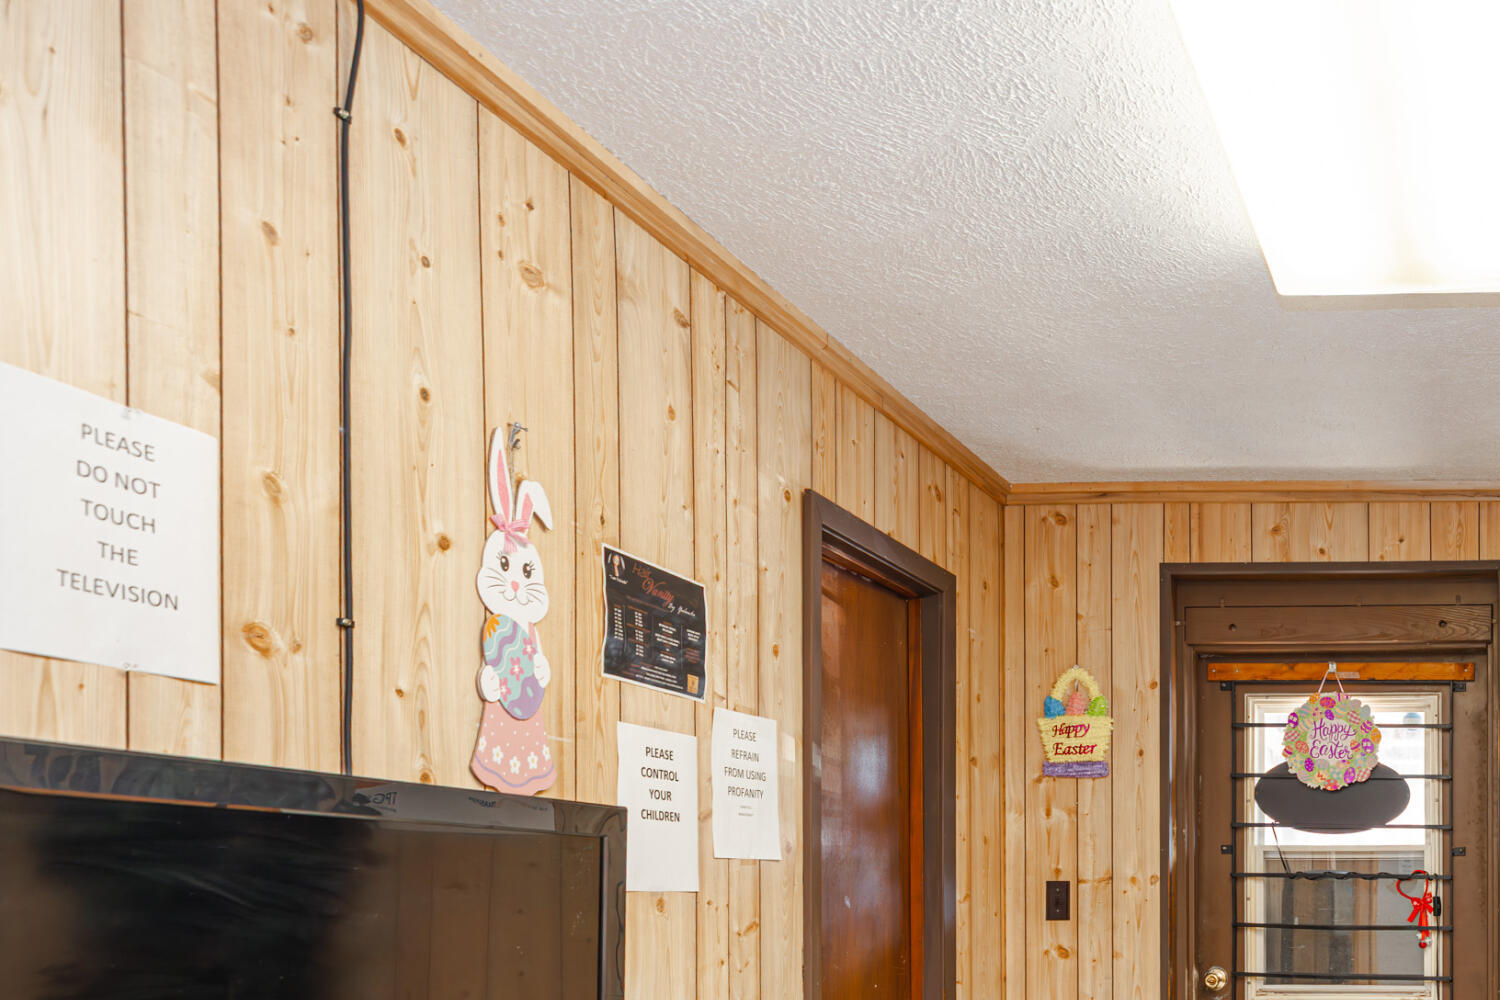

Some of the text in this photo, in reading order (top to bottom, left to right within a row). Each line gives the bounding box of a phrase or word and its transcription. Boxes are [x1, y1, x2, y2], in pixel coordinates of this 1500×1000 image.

[81, 423, 156, 462] PLEASE
[76, 460, 161, 499] DO NOT
[81, 499, 156, 534] TOUCH
[97, 541, 139, 566] THE
[57, 568, 179, 611] TELEVISION
[733, 728, 757, 742] PLEASE
[1051, 720, 1091, 738] Happy
[1311, 719, 1357, 741] Happy
[645, 746, 674, 760] PLEASE
[731, 748, 760, 762] REFRAIN
[1053, 741, 1097, 757] Easter
[1309, 740, 1354, 759] Easter
[641, 767, 679, 782] CONTROL
[724, 766, 767, 782] FROM USING
[649, 789, 672, 801] YOUR
[727, 785, 764, 799] PROFANITY
[641, 809, 680, 822] CHILDREN
